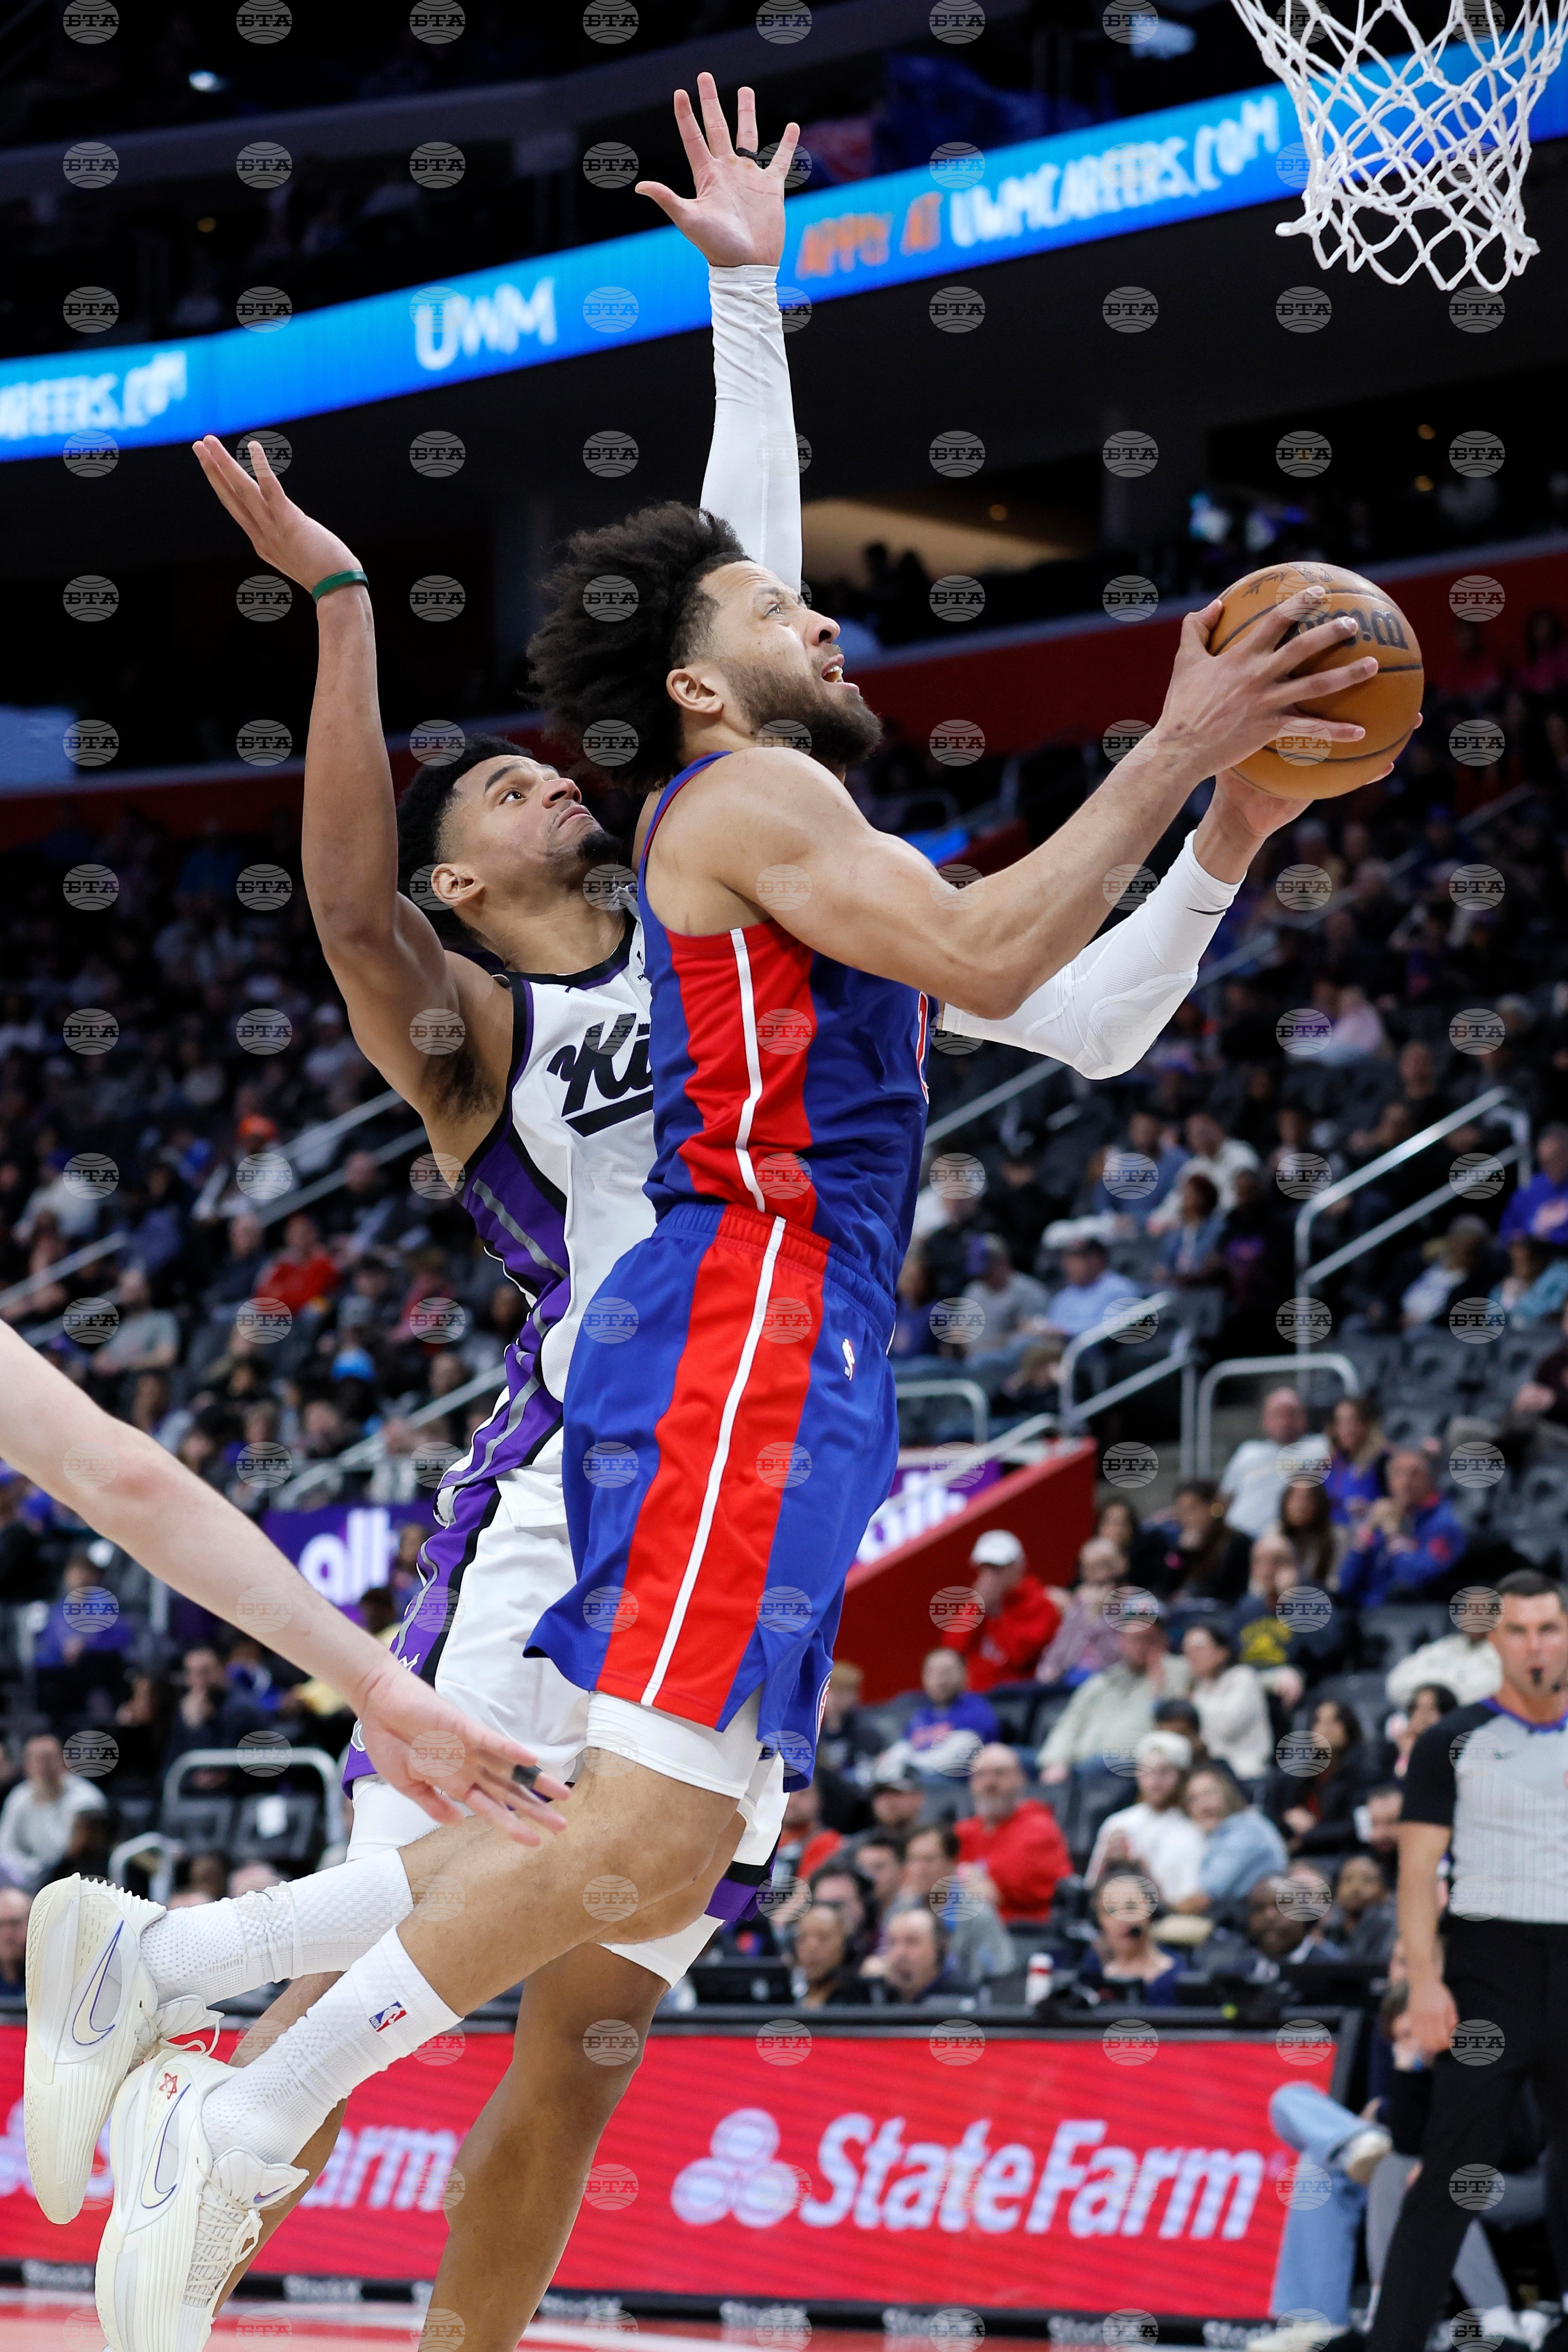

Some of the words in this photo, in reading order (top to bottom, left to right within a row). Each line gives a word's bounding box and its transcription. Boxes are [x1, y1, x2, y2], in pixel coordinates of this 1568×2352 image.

[414, 277, 557, 371] UWM
[546, 1013, 653, 1118] Ki
[297, 2125, 457, 2213] arm
